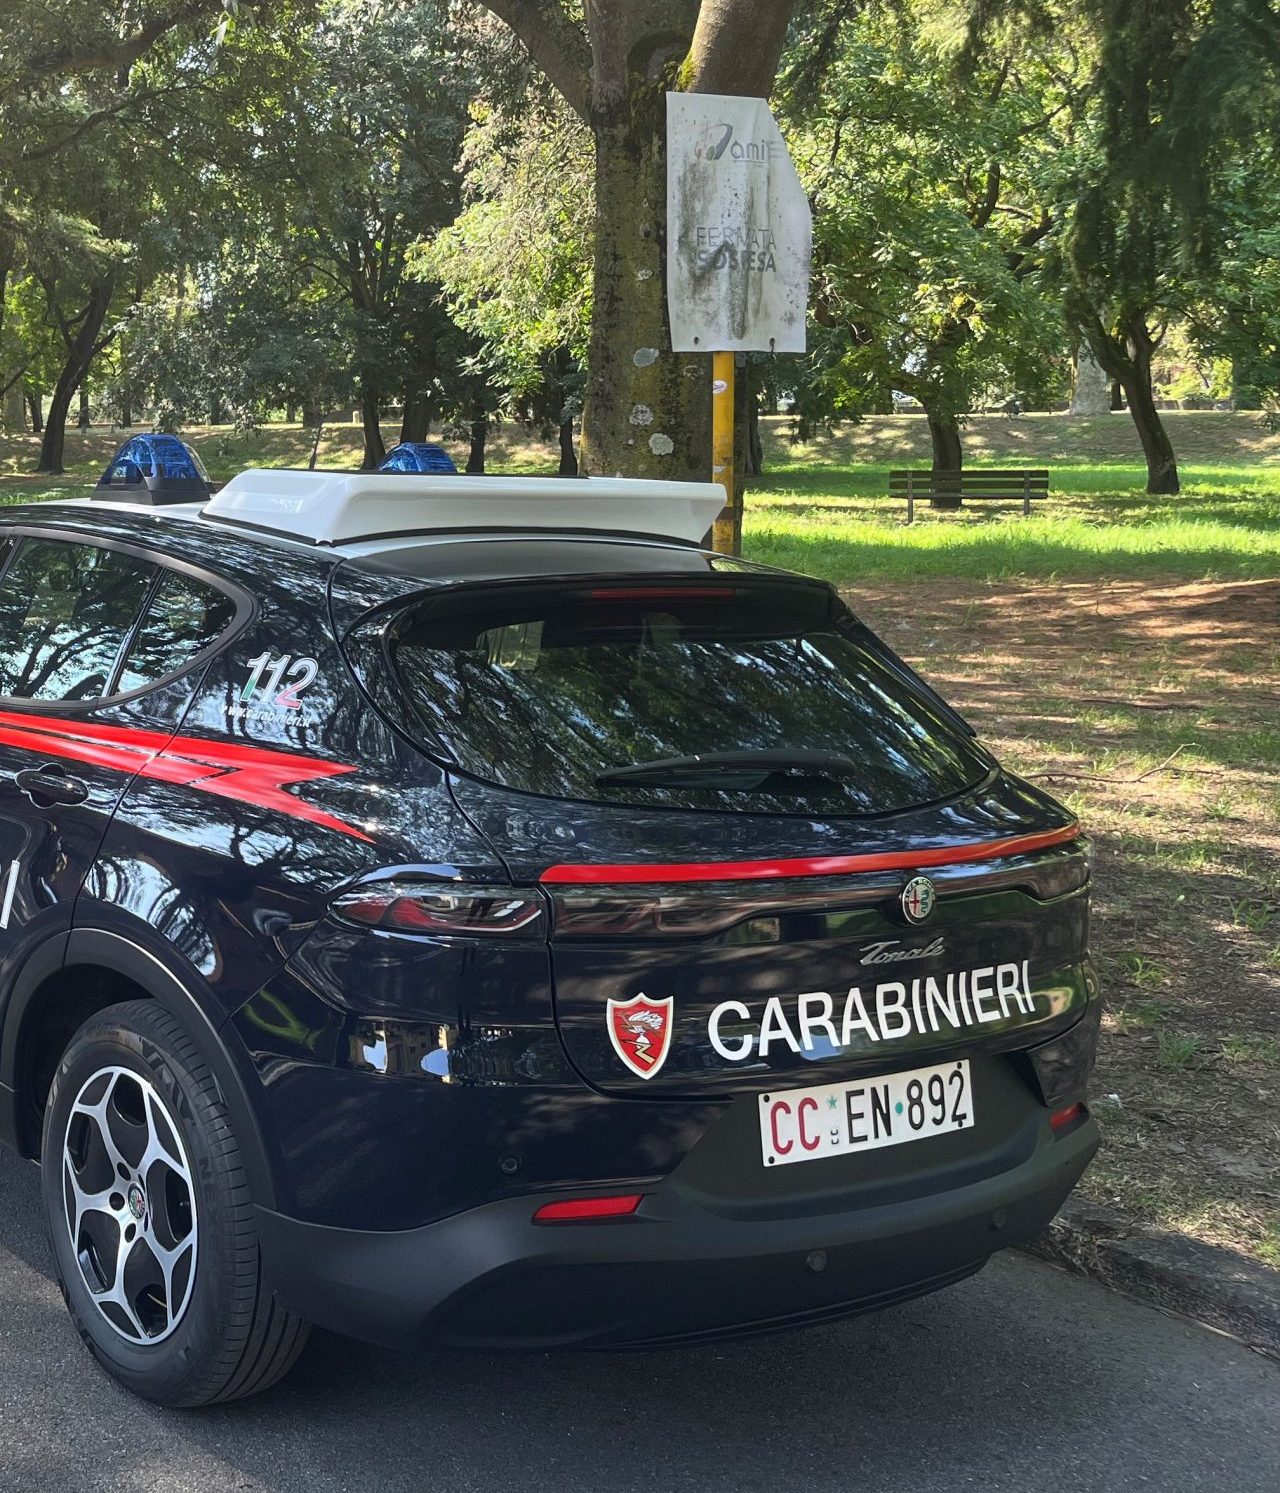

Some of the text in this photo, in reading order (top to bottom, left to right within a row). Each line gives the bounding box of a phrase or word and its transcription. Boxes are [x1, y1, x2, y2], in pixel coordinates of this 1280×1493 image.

[240, 652, 319, 710] 112
[859, 937, 945, 965] Tonale
[707, 960, 1037, 1060] CARABINIERI
[770, 1097, 821, 1155] CC
[845, 1084, 892, 1143] EN
[906, 1069, 967, 1130] 892
